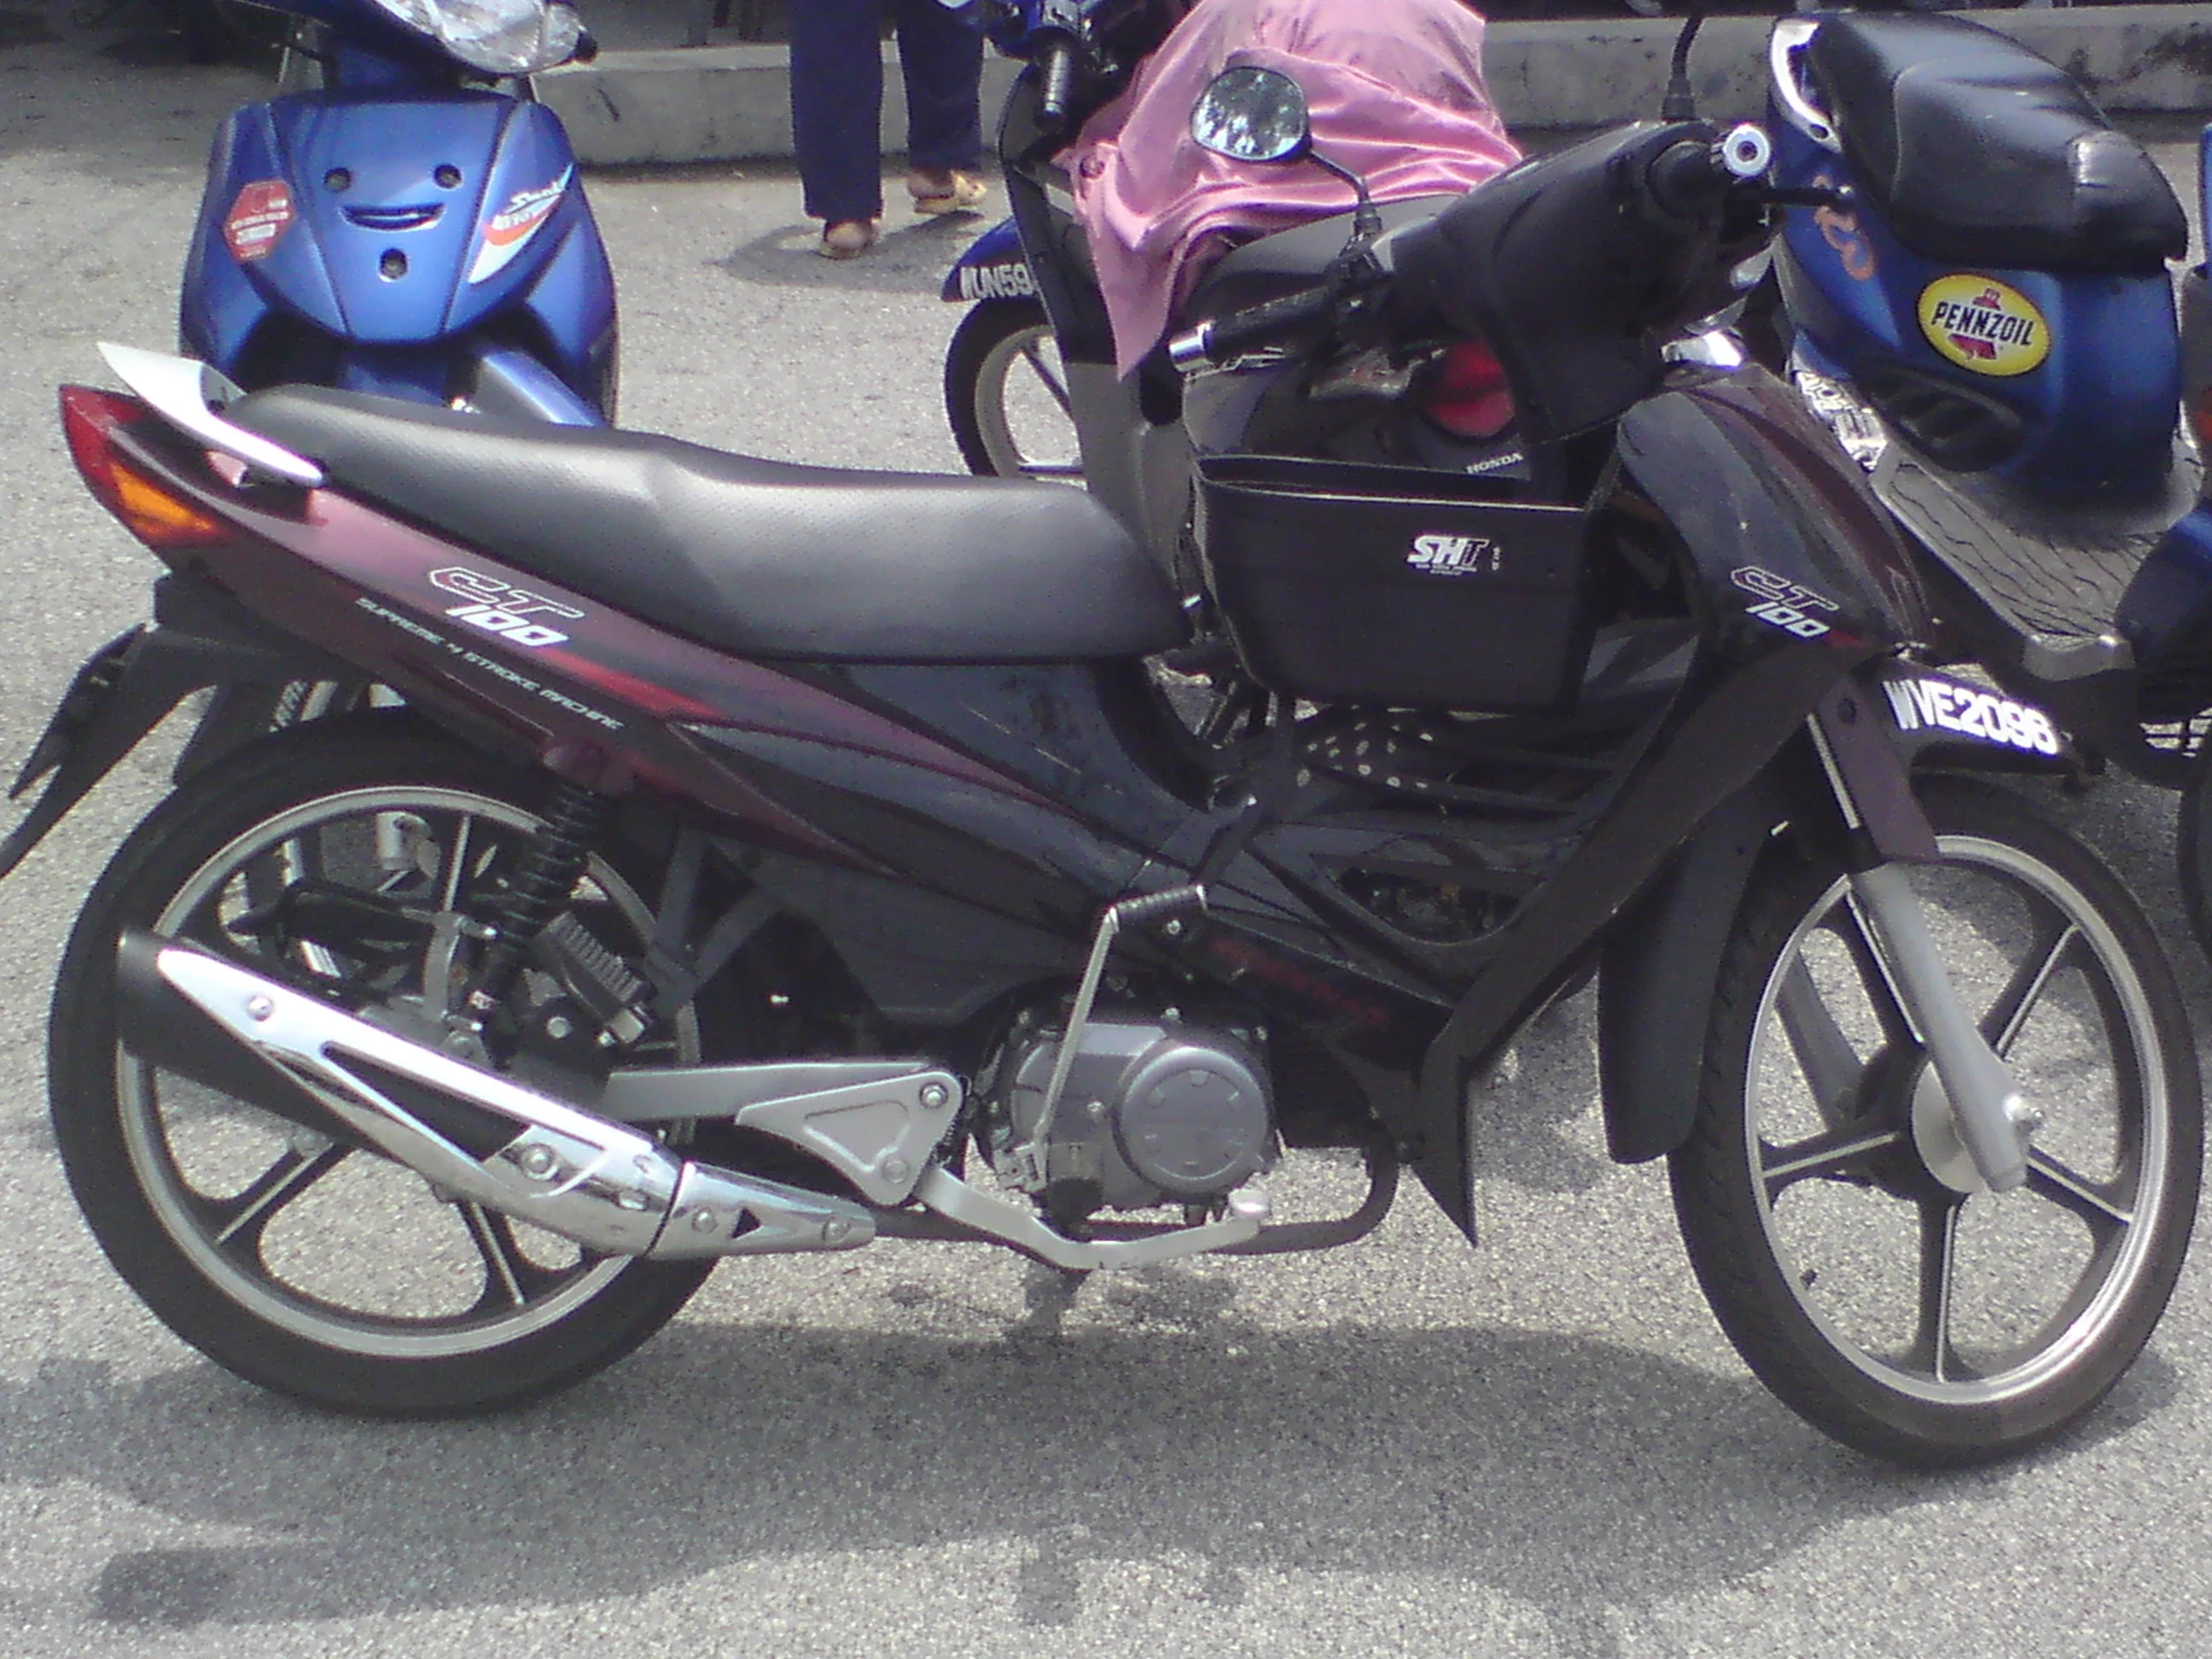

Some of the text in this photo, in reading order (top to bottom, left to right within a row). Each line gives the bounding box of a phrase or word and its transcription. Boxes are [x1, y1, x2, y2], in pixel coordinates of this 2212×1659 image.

[1930, 301, 2035, 346] PENNZOIL
[1467, 451, 1524, 474] HONDA
[444, 604, 569, 646] 100
[1745, 602, 1831, 637] 100
[355, 597, 626, 731] SUPREME 4 STROKE MACHINE
